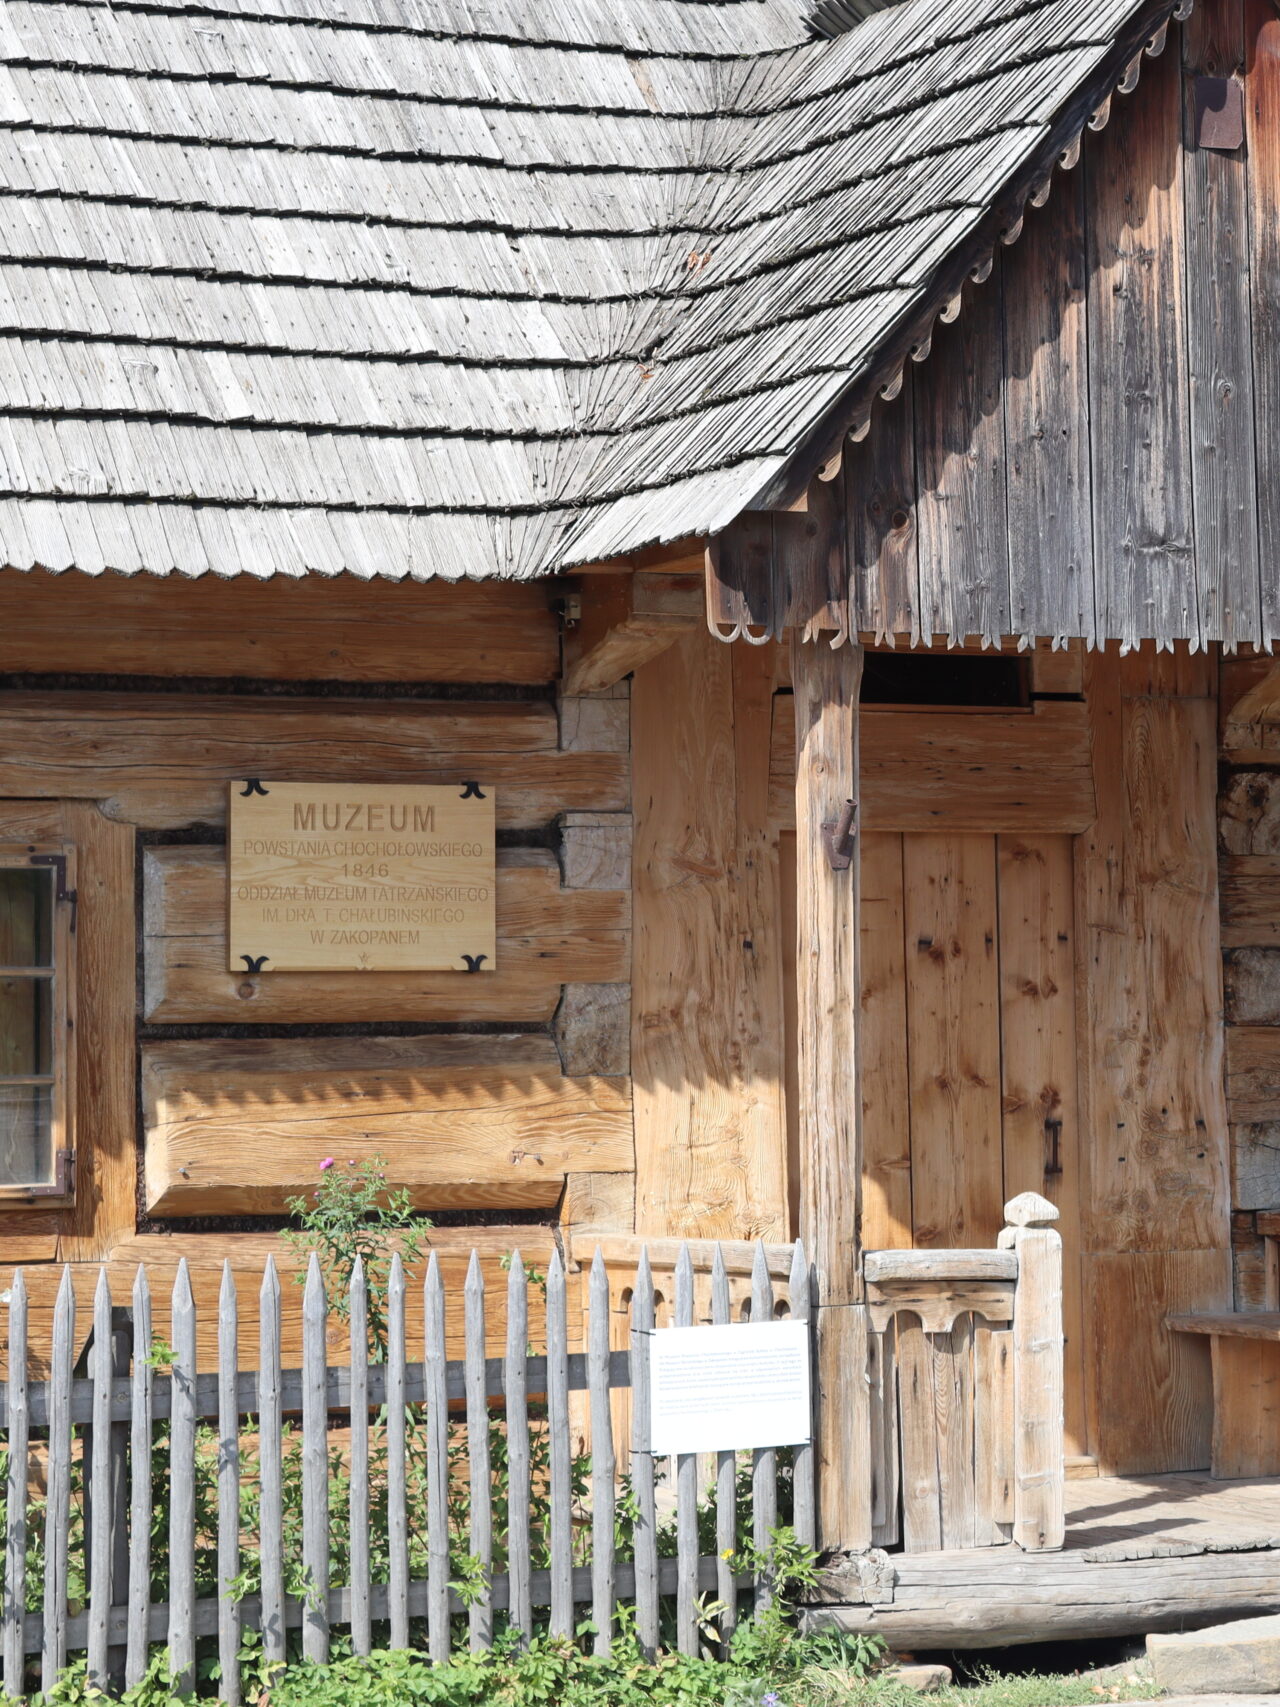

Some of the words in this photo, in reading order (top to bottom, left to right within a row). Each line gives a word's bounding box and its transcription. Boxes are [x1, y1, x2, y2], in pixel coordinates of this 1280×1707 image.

[293, 802, 436, 833] MUZEUM
[243, 840, 331, 857] POWSTANIA
[333, 841, 483, 858] CHOCHOŁOWSKIEGO
[341, 863, 390, 878] 1846
[237, 886, 303, 901] ODDZIAŁ
[304, 886, 367, 902] MUZEUM
[372, 883, 489, 903] TATRZAŃSKIEGO
[286, 907, 317, 923] DRA
[338, 905, 465, 924] CHAŁUBIŃSKIEGO
[310, 929, 325, 945] W
[330, 929, 420, 945] ZAKOPANEM
